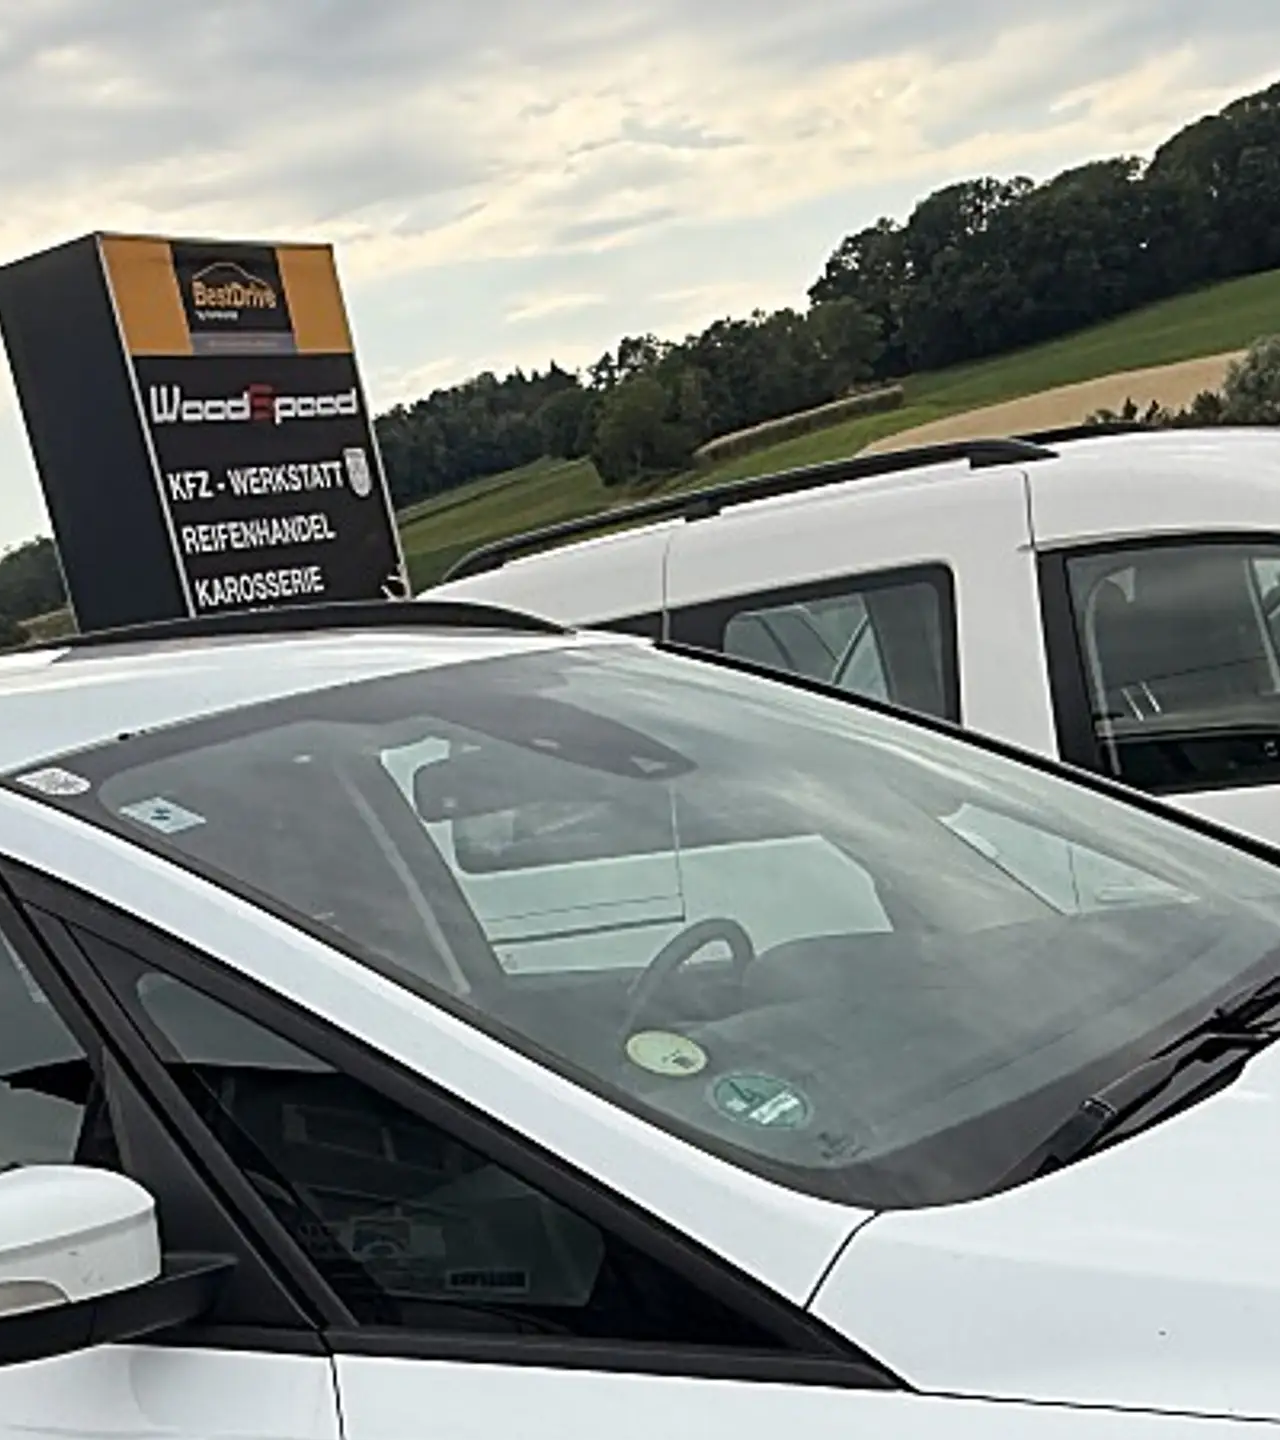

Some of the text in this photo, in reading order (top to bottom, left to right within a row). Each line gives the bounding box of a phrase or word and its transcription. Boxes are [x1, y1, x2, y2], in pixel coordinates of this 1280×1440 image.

[167, 471, 214, 501] KFZ
[227, 461, 344, 496] WERKSTATT
[181, 513, 336, 554] REIFENHANDEL
[195, 566, 324, 607] KAROSSERIE
